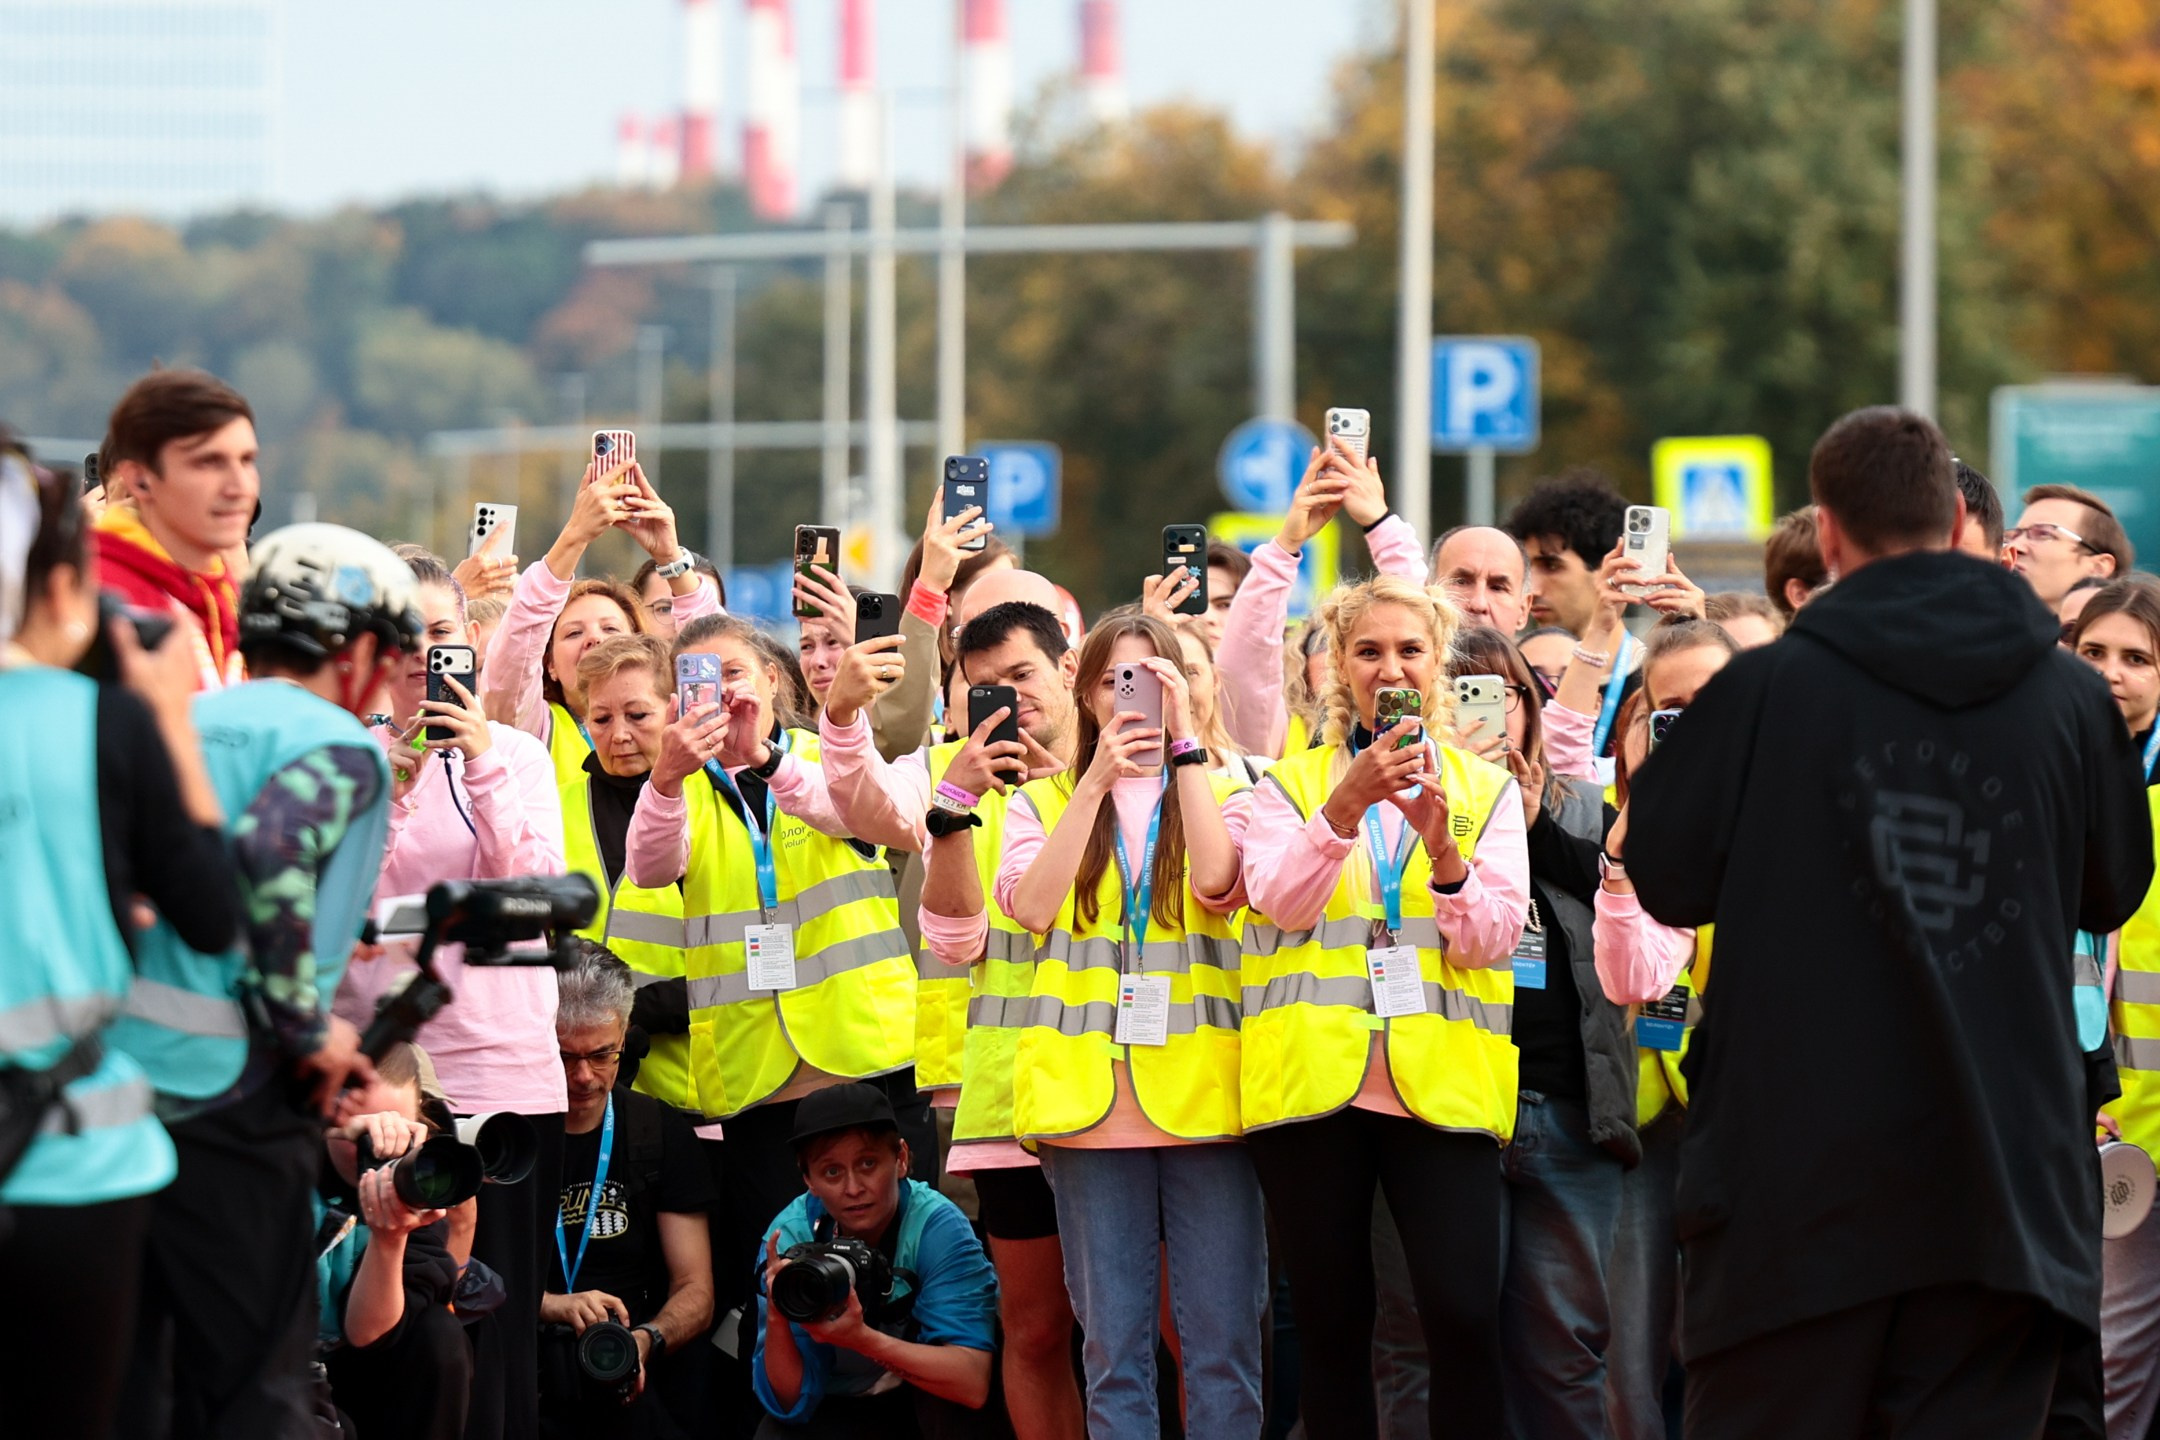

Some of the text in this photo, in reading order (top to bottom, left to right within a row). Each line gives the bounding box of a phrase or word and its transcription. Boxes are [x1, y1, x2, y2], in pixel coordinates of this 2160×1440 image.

[1449, 343, 1518, 440] P
[1370, 819, 1386, 861] ВОЛОНТЁР
[1143, 841, 1156, 886] VOLUNTEER
[586, 1183, 602, 1229] VOLUNTEER
[832, 1243, 851, 1251] Canon
